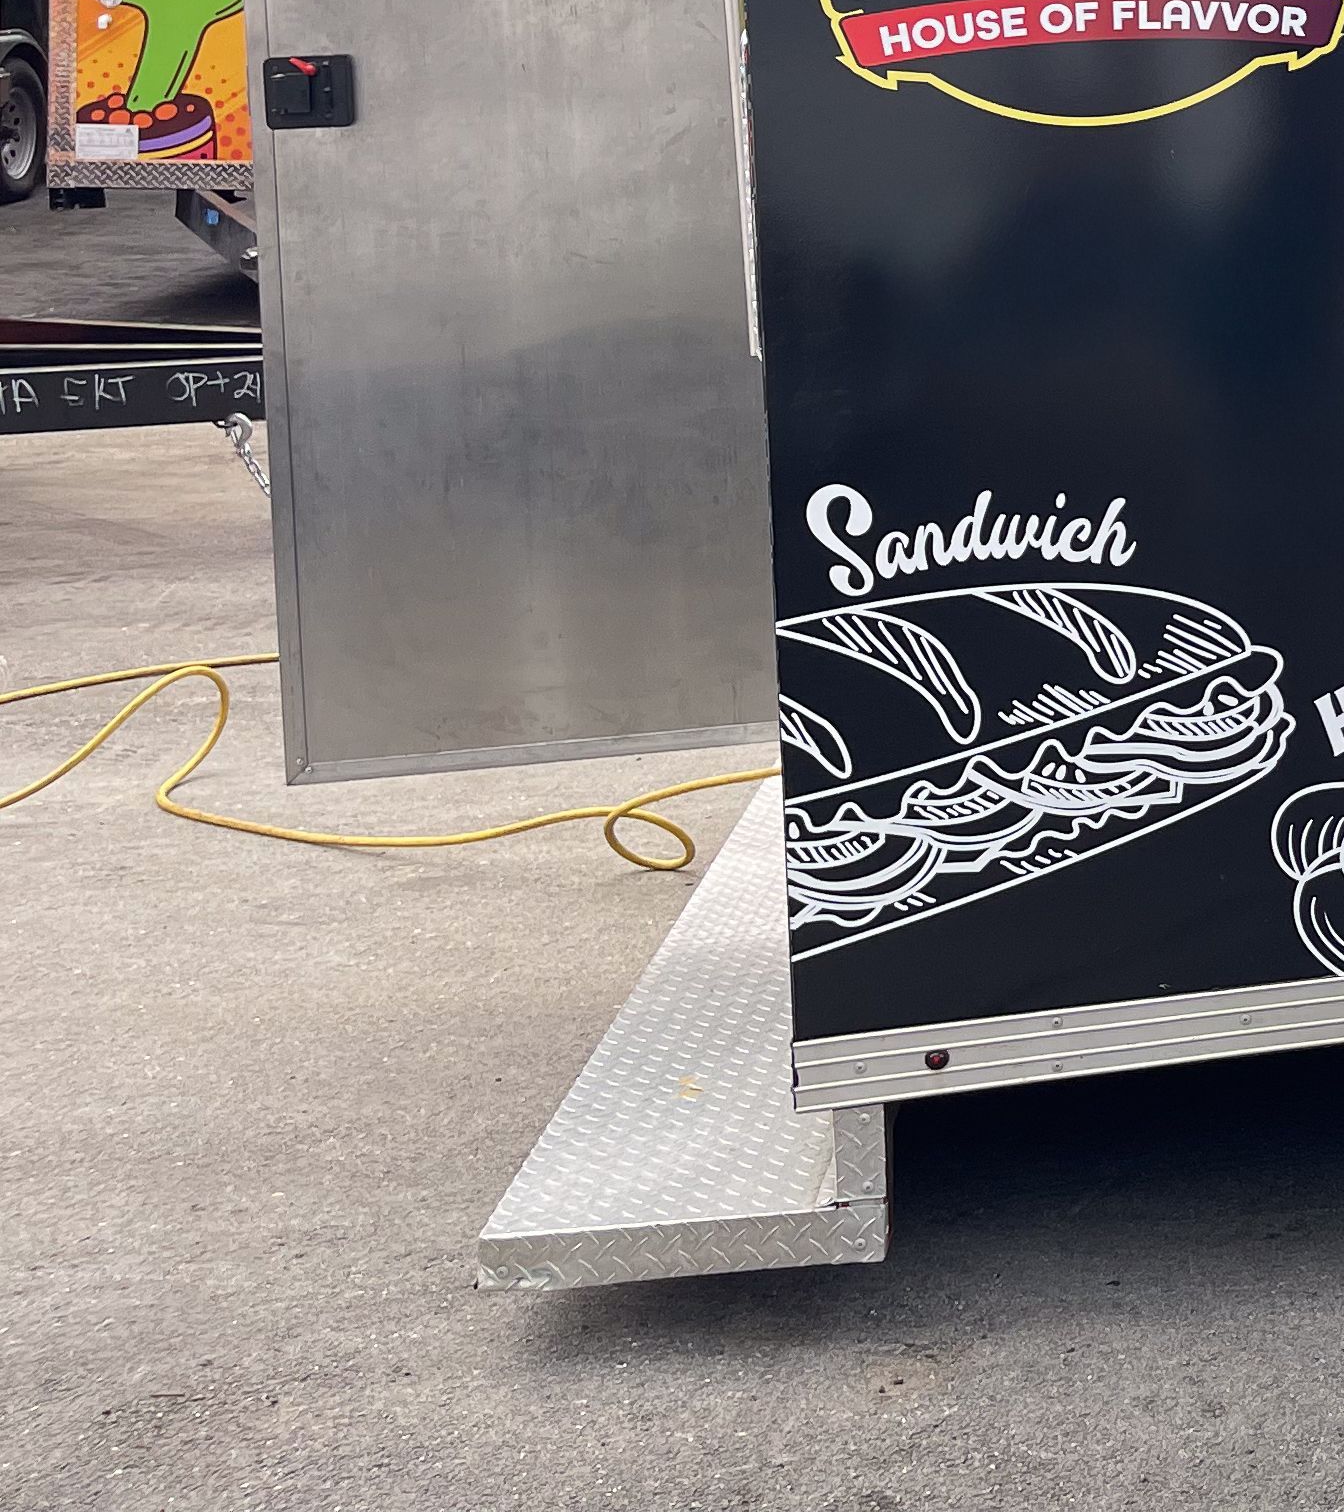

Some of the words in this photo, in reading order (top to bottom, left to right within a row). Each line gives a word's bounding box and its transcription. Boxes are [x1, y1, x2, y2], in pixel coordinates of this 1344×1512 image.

[878, 6, 1028, 58] HOUSE
[1038, 3, 1101, 32] OF
[1112, 0, 1309, 37] FLAVVOR
[805, 483, 1137, 597] Sandwich
